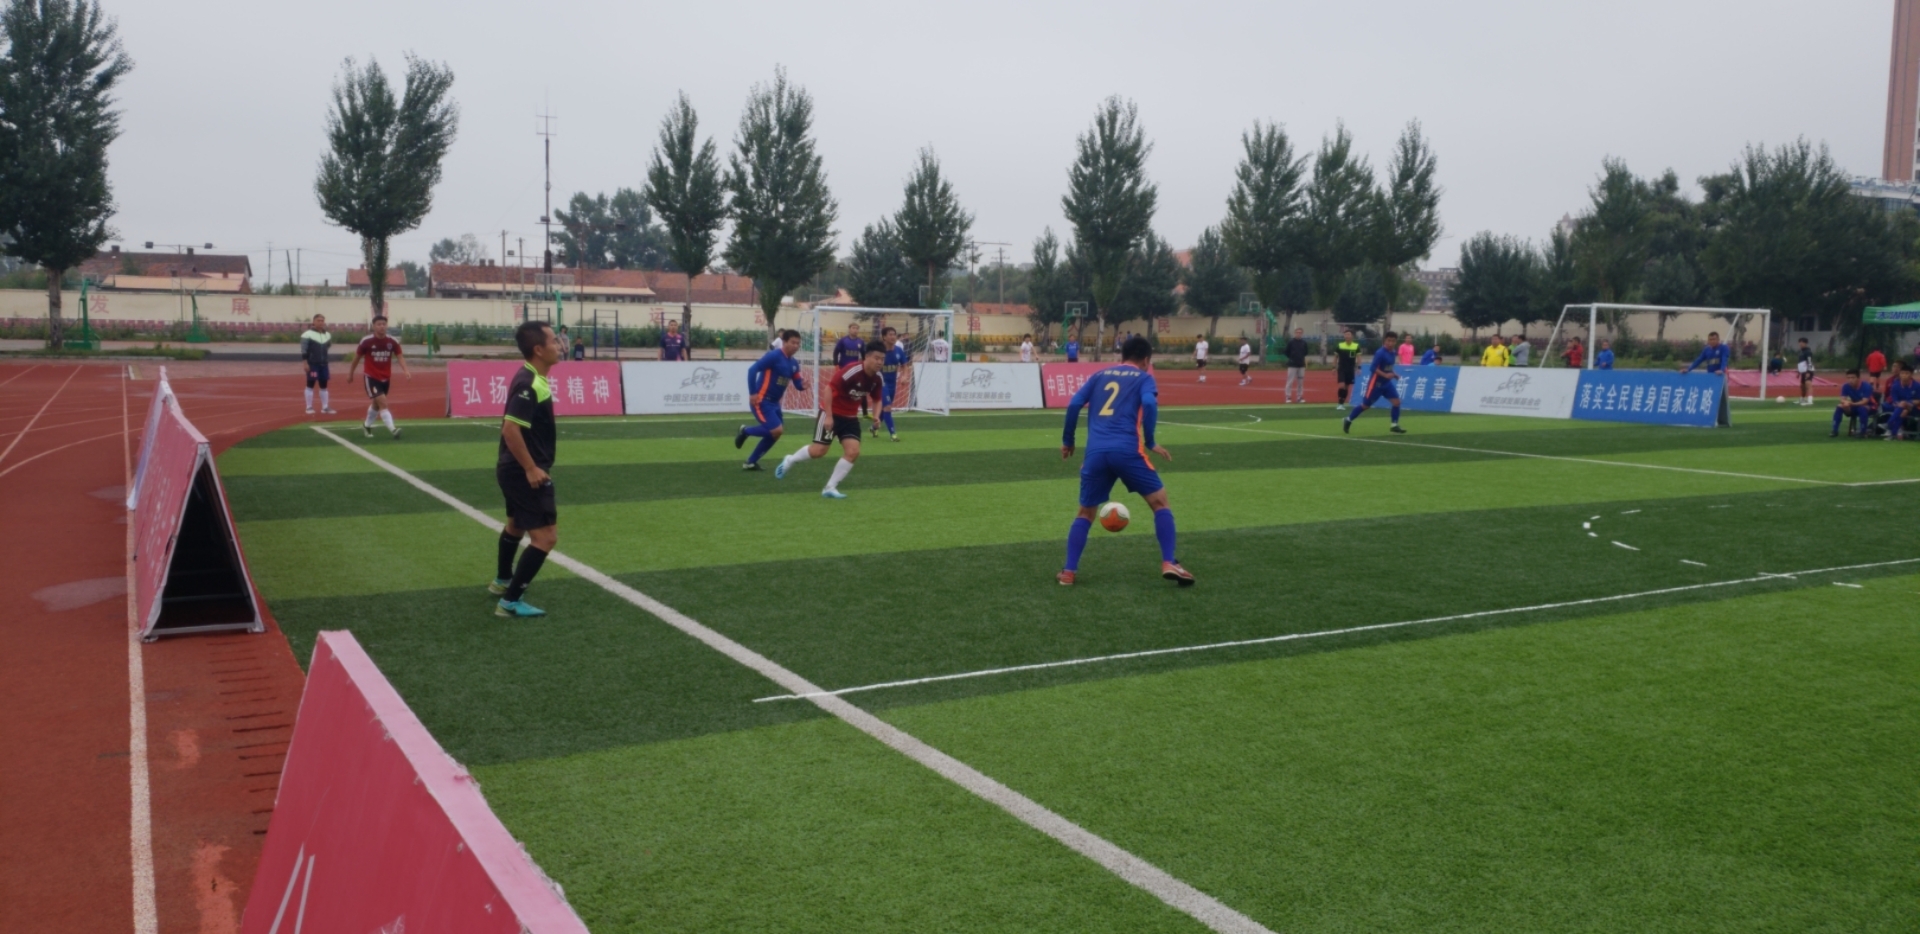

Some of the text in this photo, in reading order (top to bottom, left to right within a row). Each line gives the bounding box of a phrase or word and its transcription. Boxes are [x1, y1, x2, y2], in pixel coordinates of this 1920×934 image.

[90, 295, 110, 314] 发
[231, 297, 250, 316] 展
[462, 376, 610, 404] 弘扬荣精神
[663, 392, 741, 402] 中国足球发展基金会
[1047, 374, 1091, 397] 中国足球
[1098, 381, 1119, 416] 2
[1579, 382, 1714, 416] 落实全民健身国家战略
